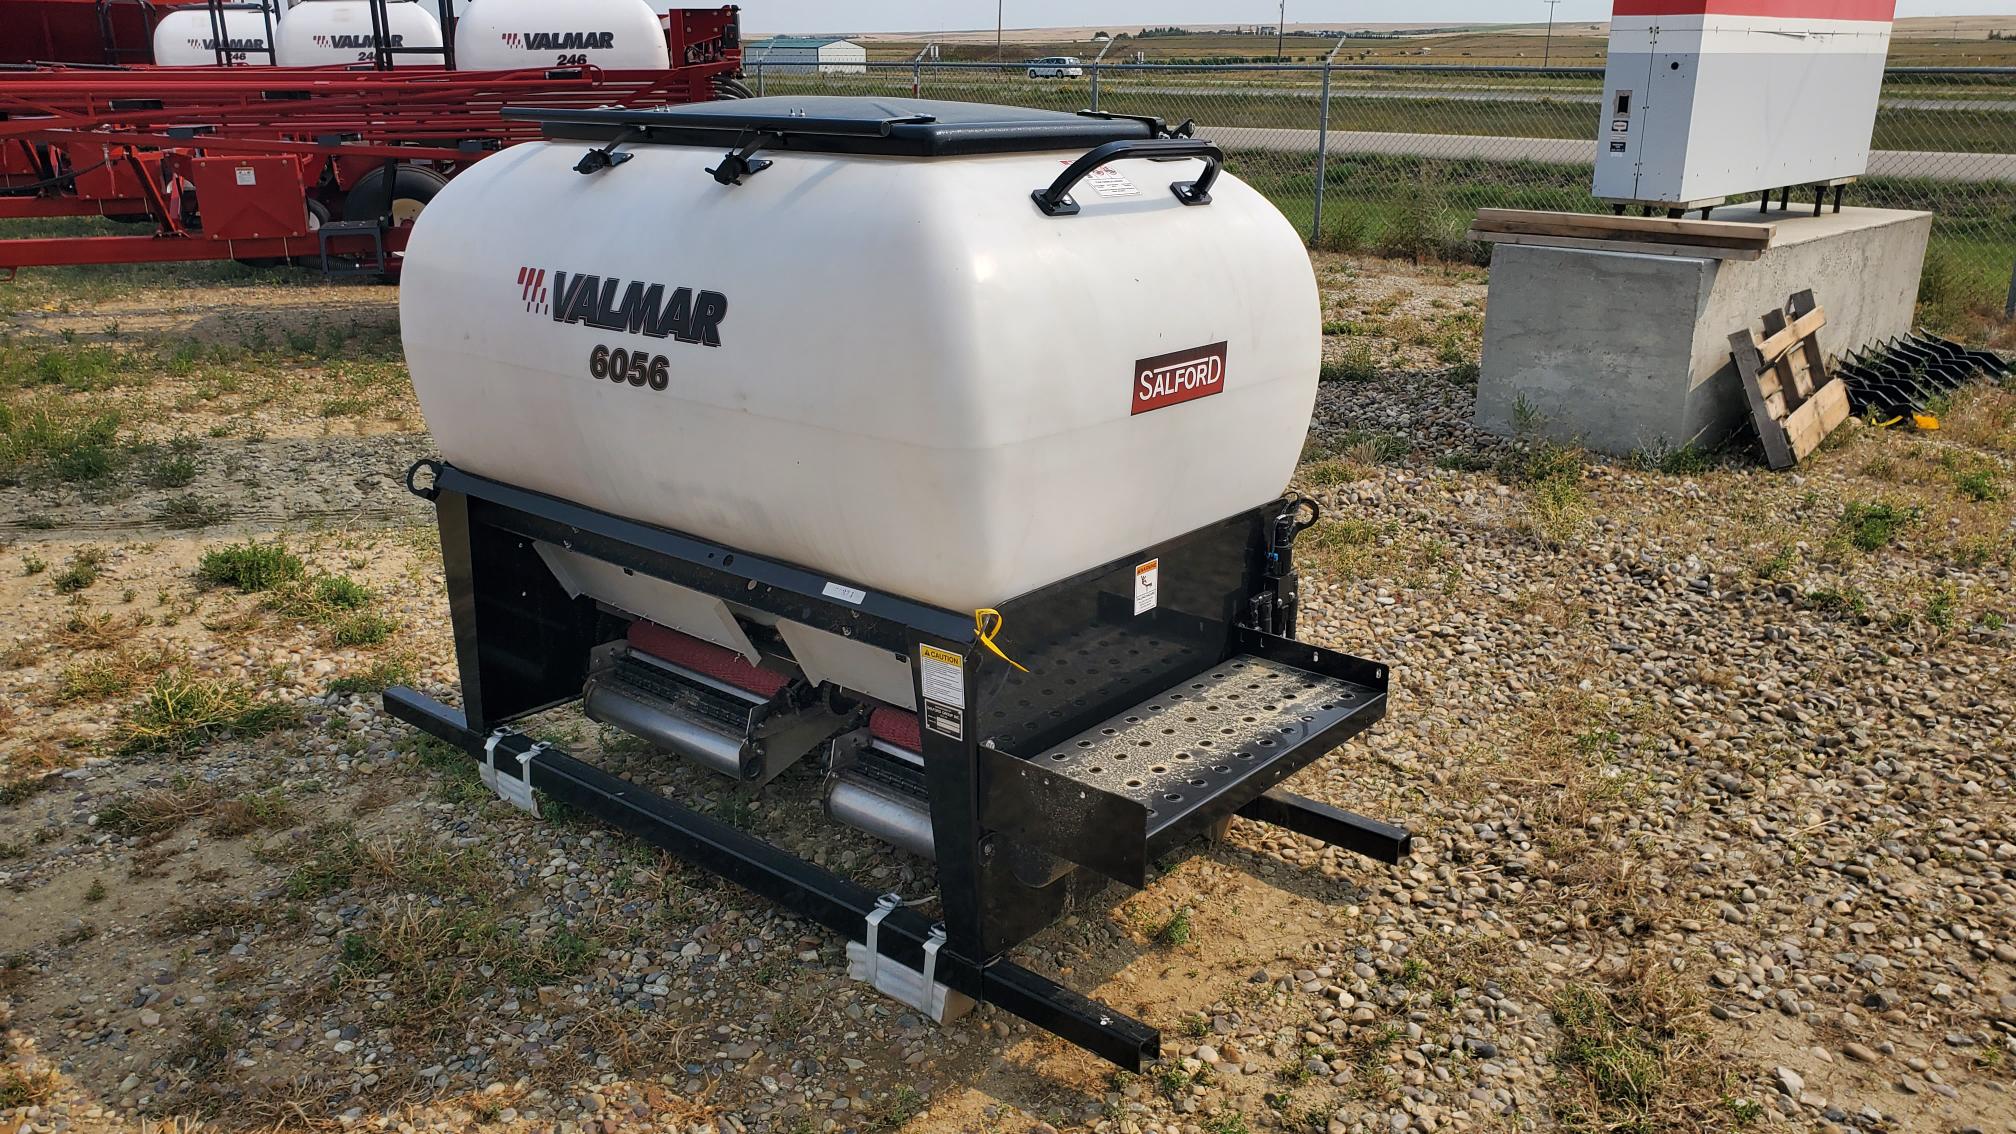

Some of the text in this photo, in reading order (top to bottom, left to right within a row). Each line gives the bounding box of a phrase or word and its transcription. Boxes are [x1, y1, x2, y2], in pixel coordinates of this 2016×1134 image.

[330, 34, 403, 48] VALMR
[523, 32, 614, 50] VALMAR
[357, 52, 377, 61] 24
[556, 54, 588, 66] 246
[552, 270, 729, 348] VALMAR
[589, 344, 670, 391] 6056
[1139, 355, 1222, 401] SALFORD
[930, 650, 959, 665] CAUTION
